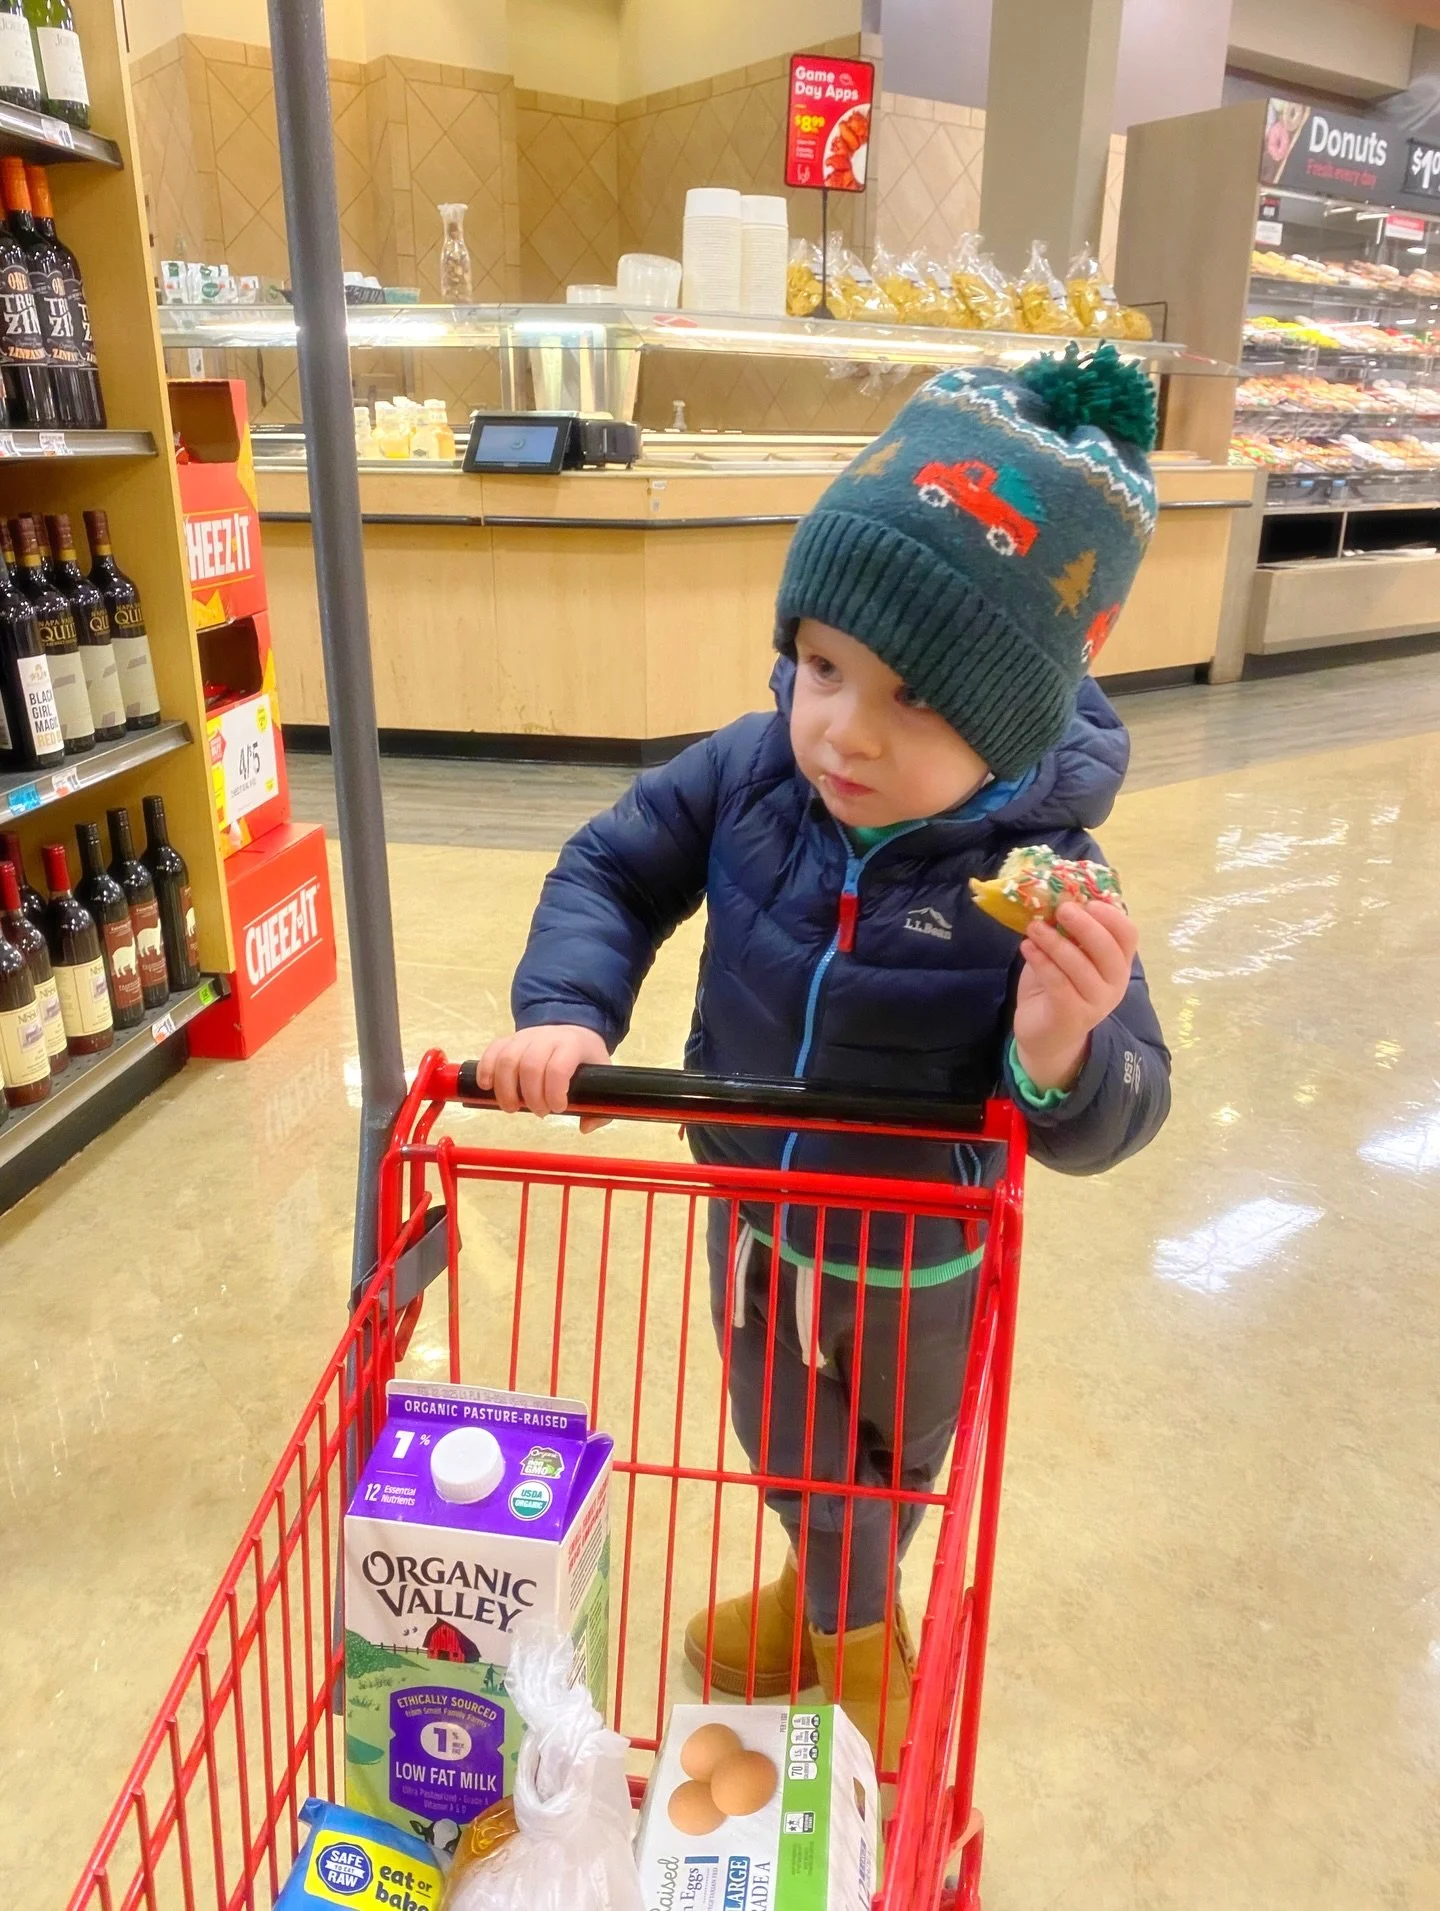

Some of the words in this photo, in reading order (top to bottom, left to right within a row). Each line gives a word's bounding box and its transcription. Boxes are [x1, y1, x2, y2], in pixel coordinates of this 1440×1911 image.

[795, 66, 835, 83] Game
[795, 81, 822, 100] Day
[825, 85, 859, 102] Apps
[1309, 116, 1388, 166] Donuts
[7, 271, 28, 292] ONE
[0, 293, 35, 313] TRU
[184, 513, 252, 581] HEEZ-IT
[40, 622, 77, 642] QUIL
[29, 689, 53, 706] BLAC
[32, 705, 52, 719] GIRL
[35, 717, 59, 733] MAGI
[37, 731, 56, 747] RED
[246, 885, 318, 986] CHEEZ-IT
[1123, 1051, 1133, 1084] 650
[404, 1399, 458, 1417] ORGANIC
[463, 1406, 568, 1430] PASTURE-RAISED
[392, 1430, 415, 1459] 1
[420, 1434, 431, 1446] %
[524, 1465, 549, 1475] GMO
[365, 1483, 381, 1502] 12
[383, 1484, 416, 1496] Essential
[381, 1494, 416, 1506] Nutrients
[521, 1488, 543, 1499] USDA
[514, 1500, 544, 1509] ORGANIC
[362, 1550, 537, 1607] ORGANIC
[376, 1584, 522, 1633] VALLEY
[397, 1694, 448, 1708] ETHICALLY
[450, 1696, 497, 1721] SOURCED
[433, 1727, 447, 1753] 1
[395, 1761, 426, 1783] LOW
[430, 1767, 456, 1787] FAT
[460, 1771, 497, 1792] MILK
[791, 1766, 803, 1777] 70
[330, 1850, 364, 1868] SAFE
[343, 1865, 355, 1873] EAT
[754, 1861, 771, 1872] A
[327, 1870, 358, 1888] RAW
[380, 1865, 415, 1890] eat
[417, 1880, 433, 1892] or
[680, 1867, 704, 1901] Eggs
[724, 1860, 748, 1911] LARGE
